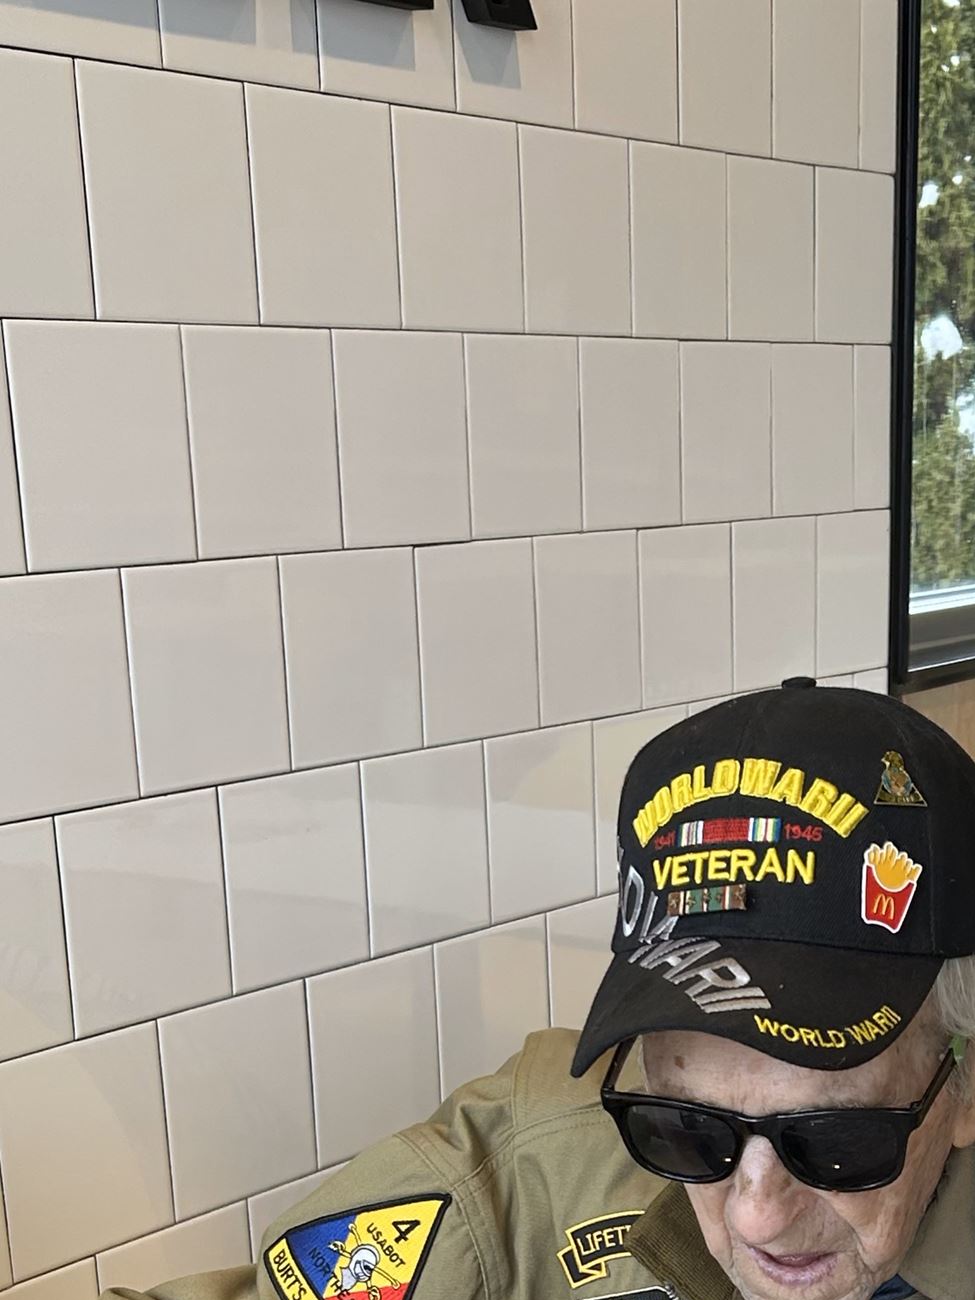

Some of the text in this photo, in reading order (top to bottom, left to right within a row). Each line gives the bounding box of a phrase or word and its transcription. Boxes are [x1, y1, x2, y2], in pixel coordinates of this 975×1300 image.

[783, 823, 824, 842] 1945
[653, 847, 815, 890] VETERAN
[754, 1014, 846, 1048] WORLD
[366, 1222, 406, 1268] USABOT
[391, 1219, 421, 1244] 4
[577, 1225, 632, 1256] LIFET
